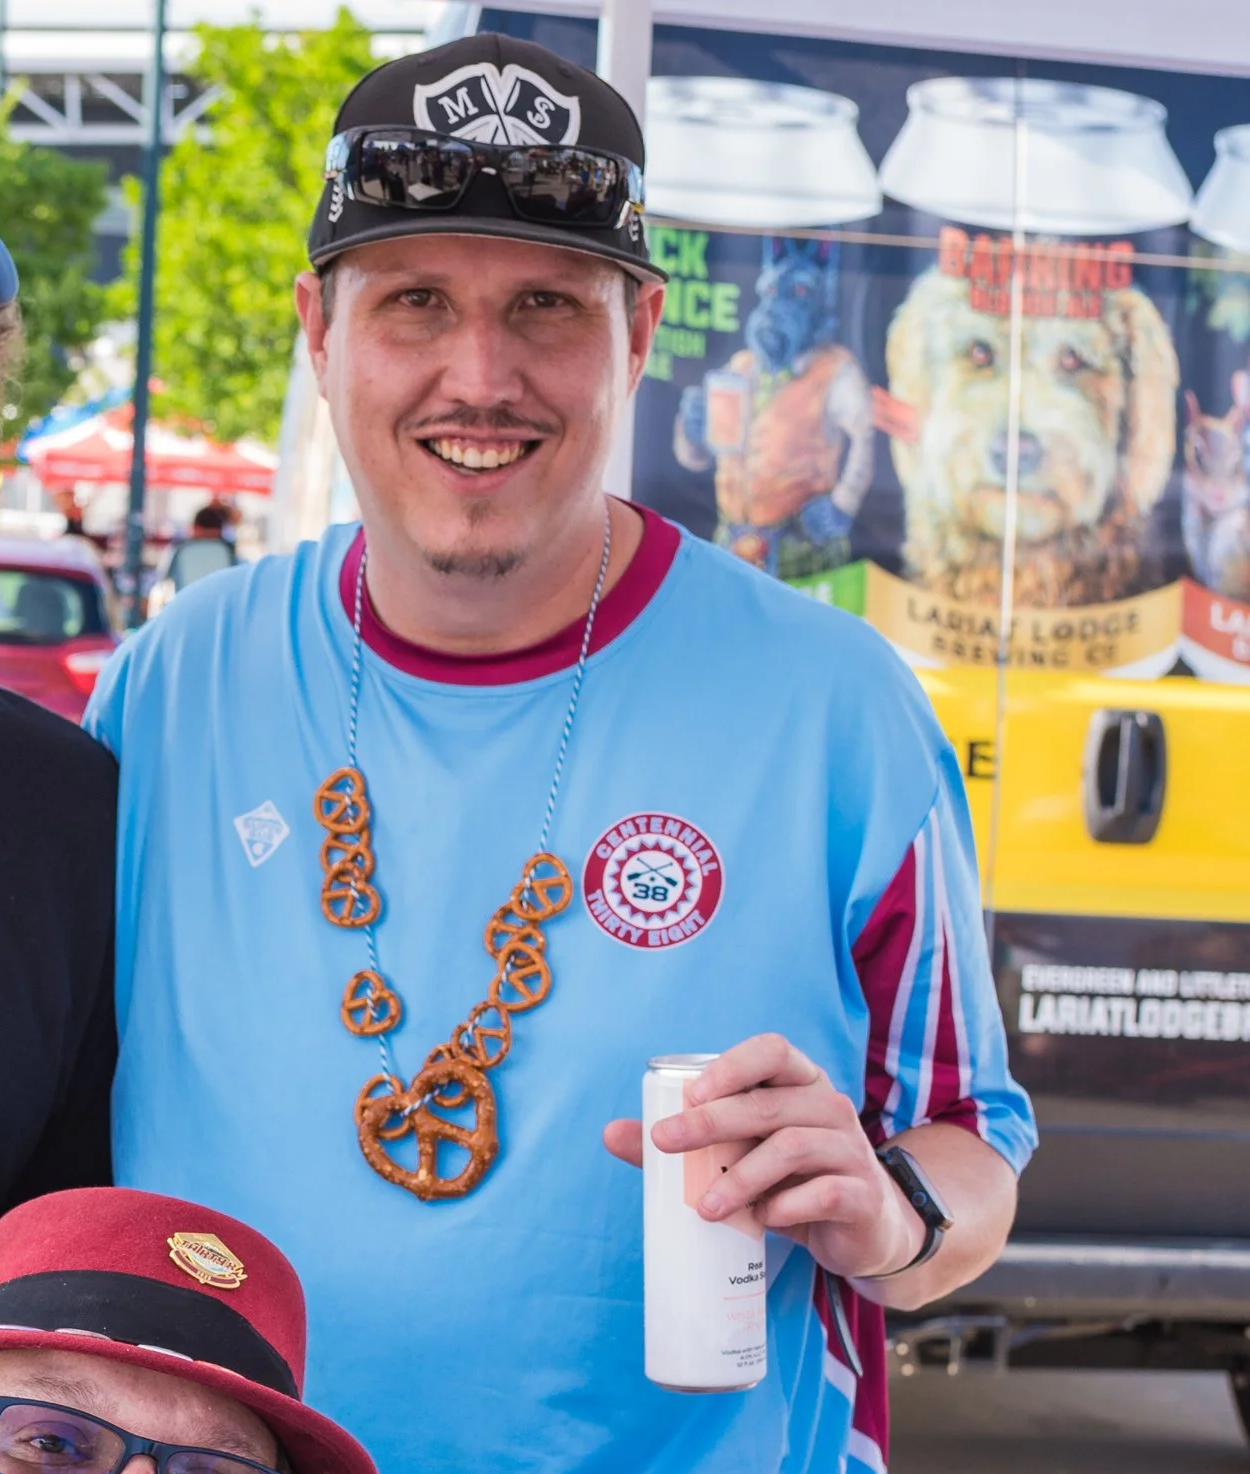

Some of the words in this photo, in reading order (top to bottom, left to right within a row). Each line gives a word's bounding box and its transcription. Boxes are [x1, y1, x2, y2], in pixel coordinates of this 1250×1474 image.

[438, 87, 478, 125] M
[526, 96, 556, 129] S
[1032, 609, 1141, 643] LODGE
[930, 632, 1072, 668] BREWING
[595, 816, 719, 877] CENTENNIAL
[632, 882, 669, 902] 38
[587, 888, 644, 944] THIRTY
[647, 909, 706, 946] EIGHT
[1136, 967, 1178, 997] AND
[729, 1273, 758, 1285] Vodka
